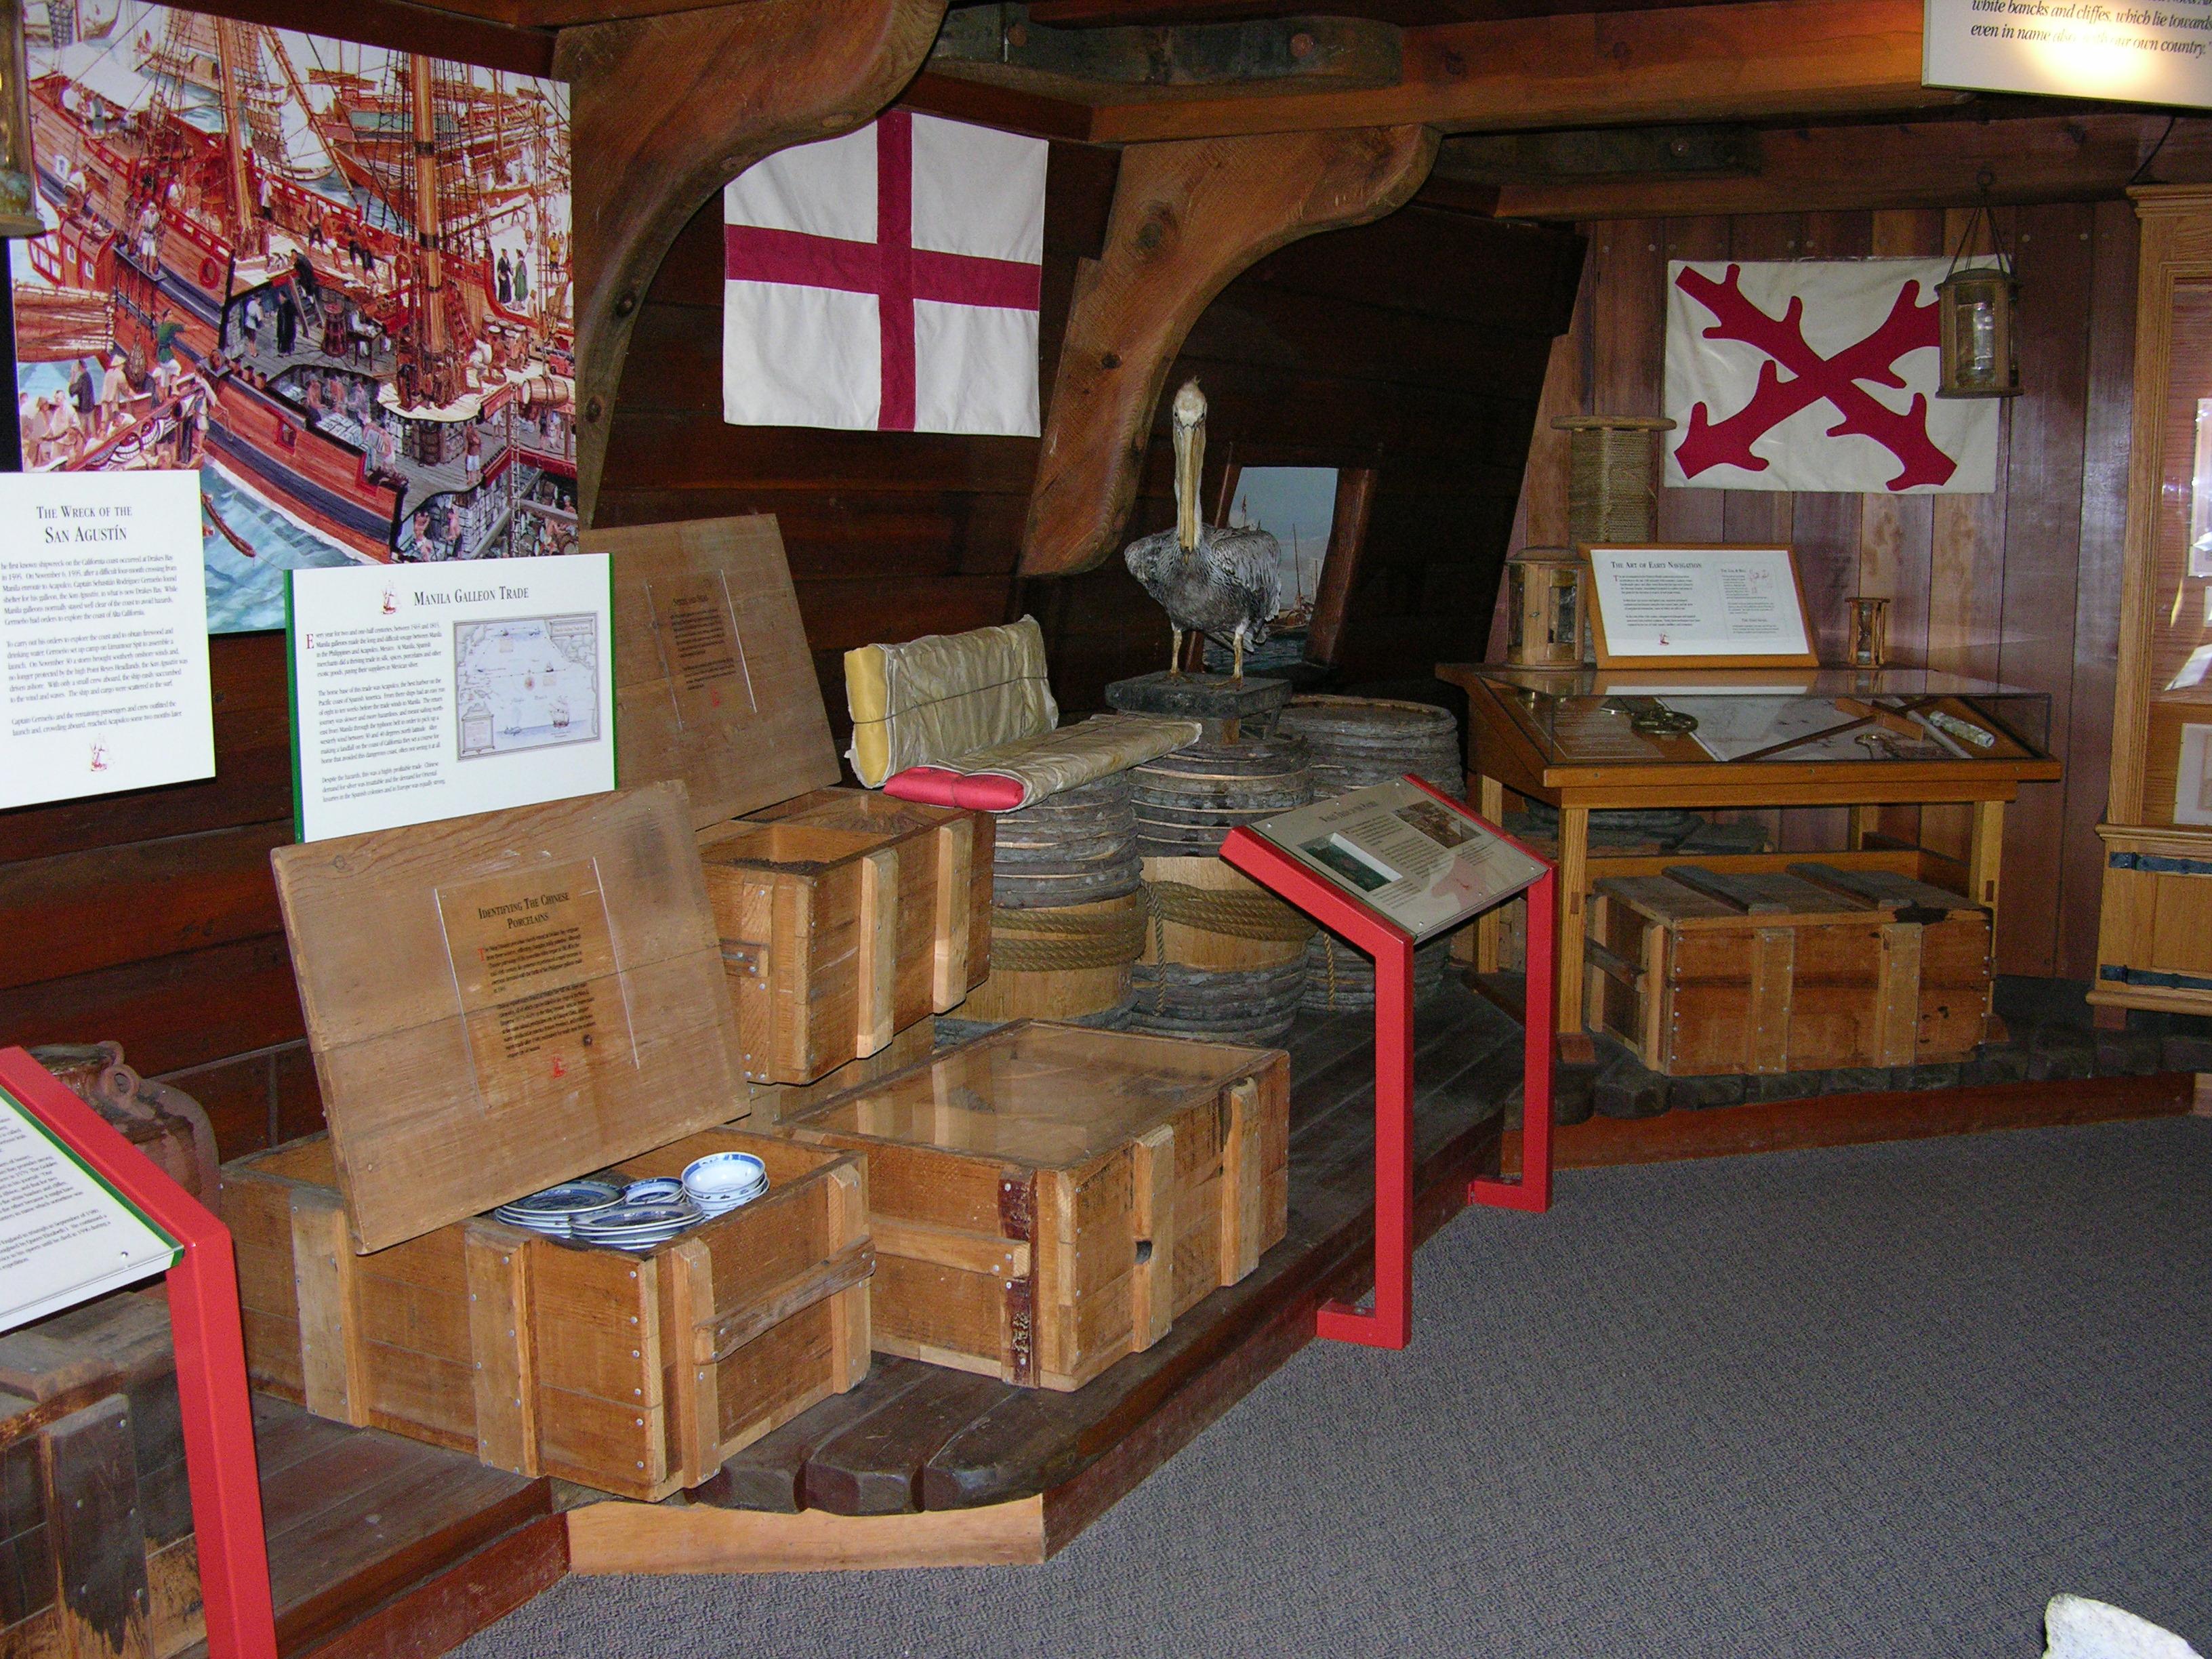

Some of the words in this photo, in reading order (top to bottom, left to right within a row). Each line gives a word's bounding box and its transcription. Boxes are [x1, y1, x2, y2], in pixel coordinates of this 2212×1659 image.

[1971, 0, 2006, 12] white
[2007, 0, 2049, 16] bancks
[2051, 4, 2075, 18] and
[2116, 8, 2150, 25] which
[2152, 11, 2167, 26] lie
[1971, 24, 1999, 37] even
[2001, 24, 2014, 39] in
[2017, 28, 2051, 42] name
[2133, 37, 2158, 51] own
[414, 591, 451, 606] MANILA
[454, 588, 495, 603] GALLEON
[499, 586, 529, 600] TRADE
